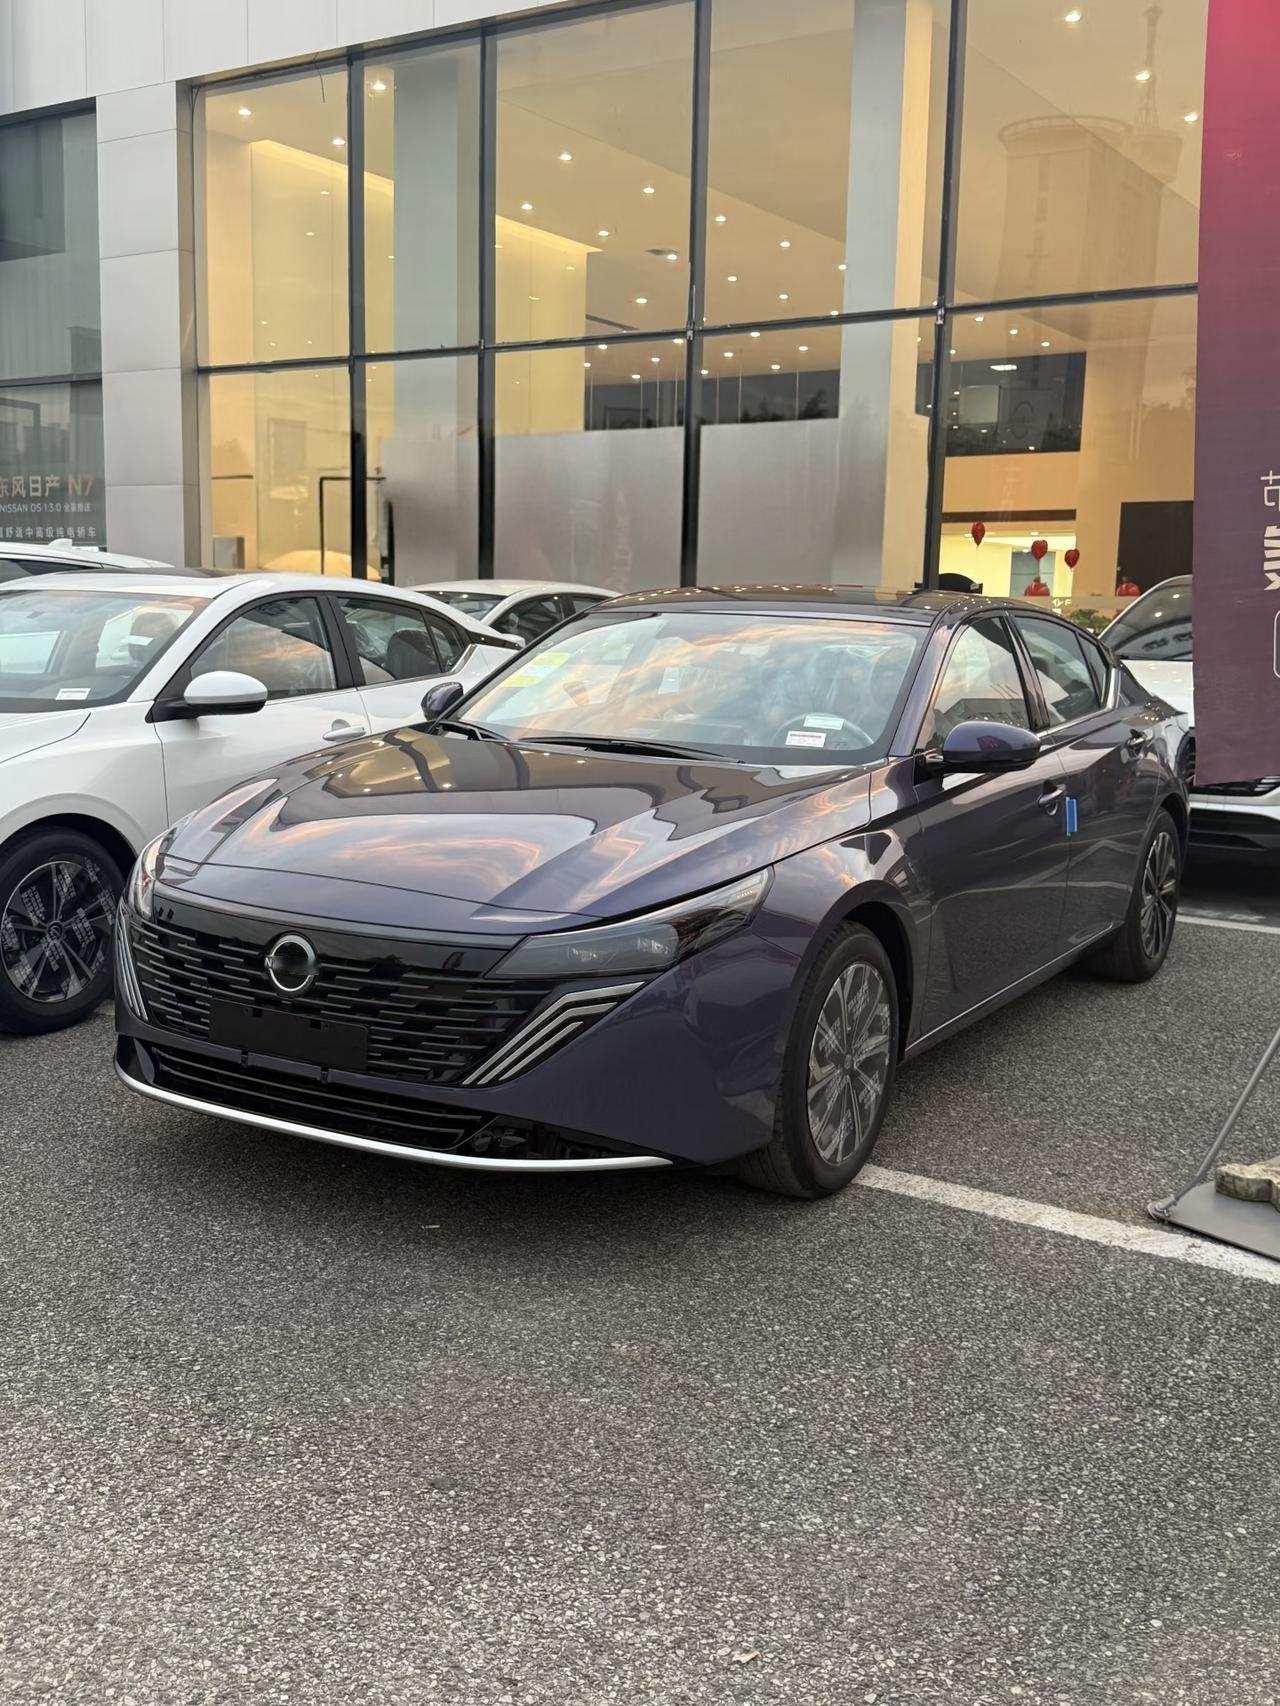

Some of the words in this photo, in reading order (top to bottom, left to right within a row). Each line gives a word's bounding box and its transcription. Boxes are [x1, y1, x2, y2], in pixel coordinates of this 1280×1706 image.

[0, 474, 60, 498] 东风日产
[68, 474, 96, 497] N7
[0, 503, 28, 513] NISSAN
[30, 503, 42, 513] OS
